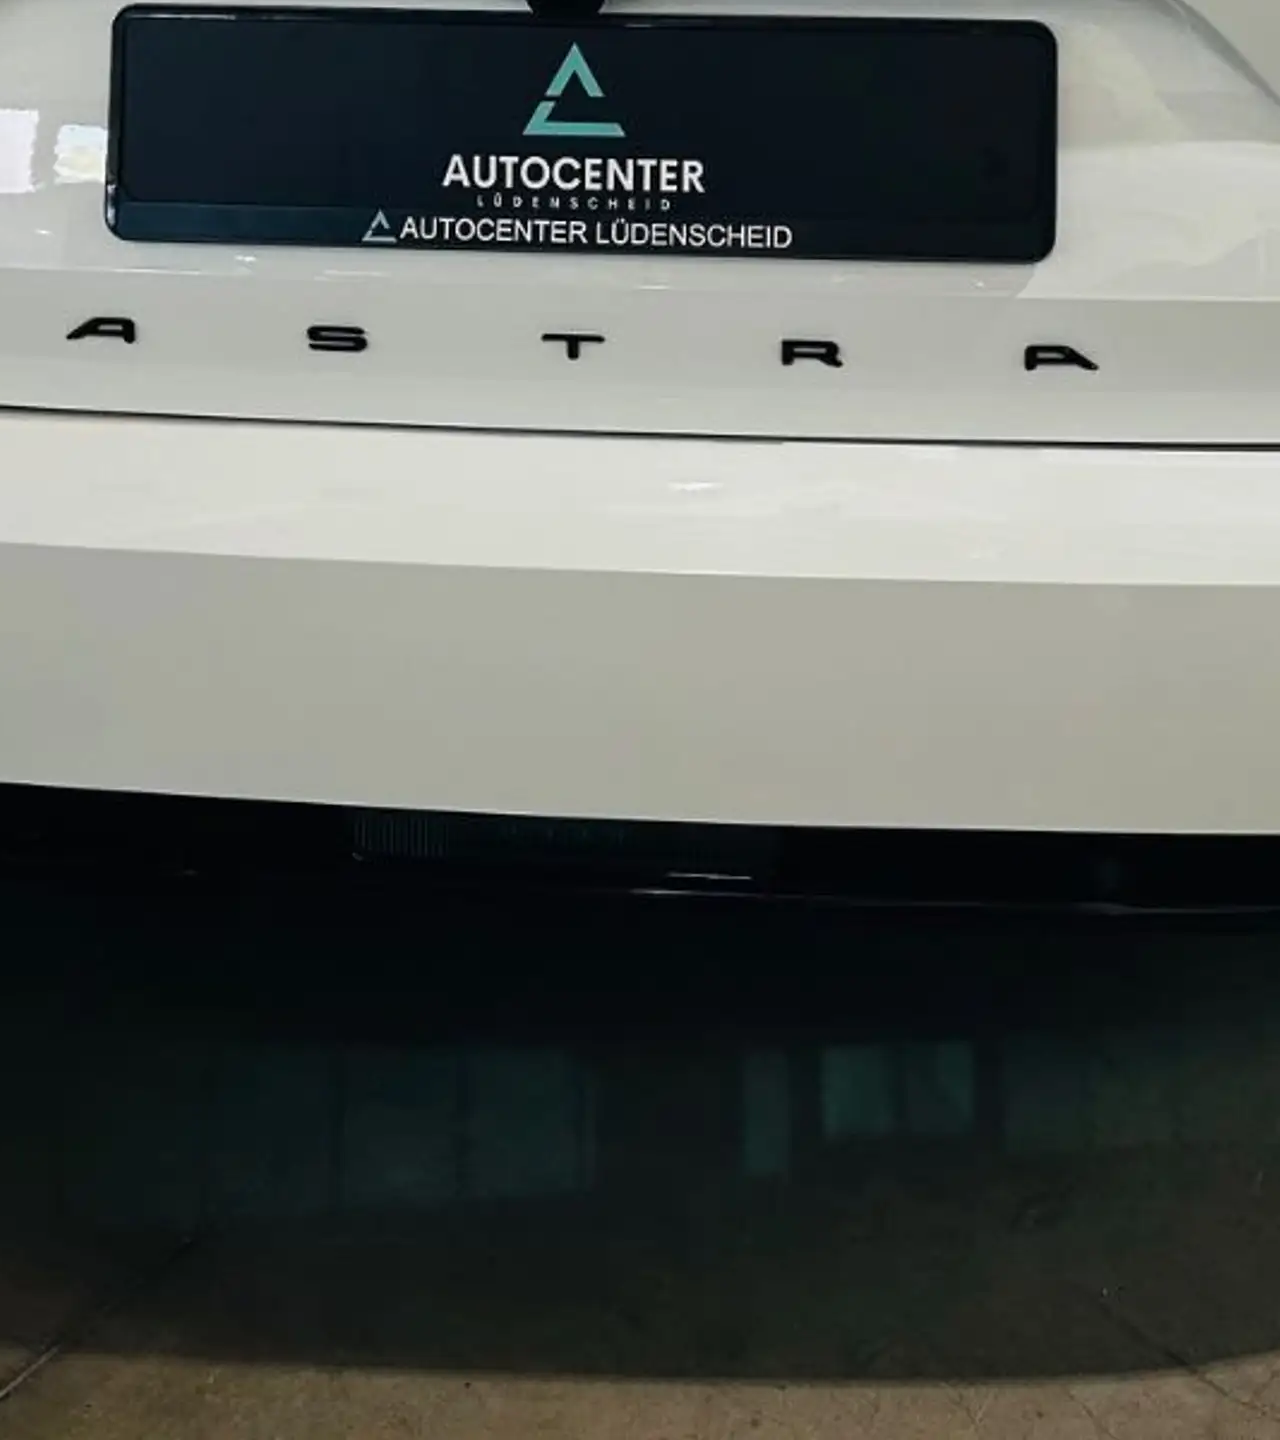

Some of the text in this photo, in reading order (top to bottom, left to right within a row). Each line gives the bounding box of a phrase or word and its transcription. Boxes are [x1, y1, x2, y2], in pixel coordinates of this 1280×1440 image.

[441, 153, 707, 194] AUTOCENTER
[476, 193, 672, 211] LÜDENSCHEID
[399, 215, 793, 250] AUTOCENTER LÜDENSCHEID
[65, 315, 1100, 372] ASTRA
